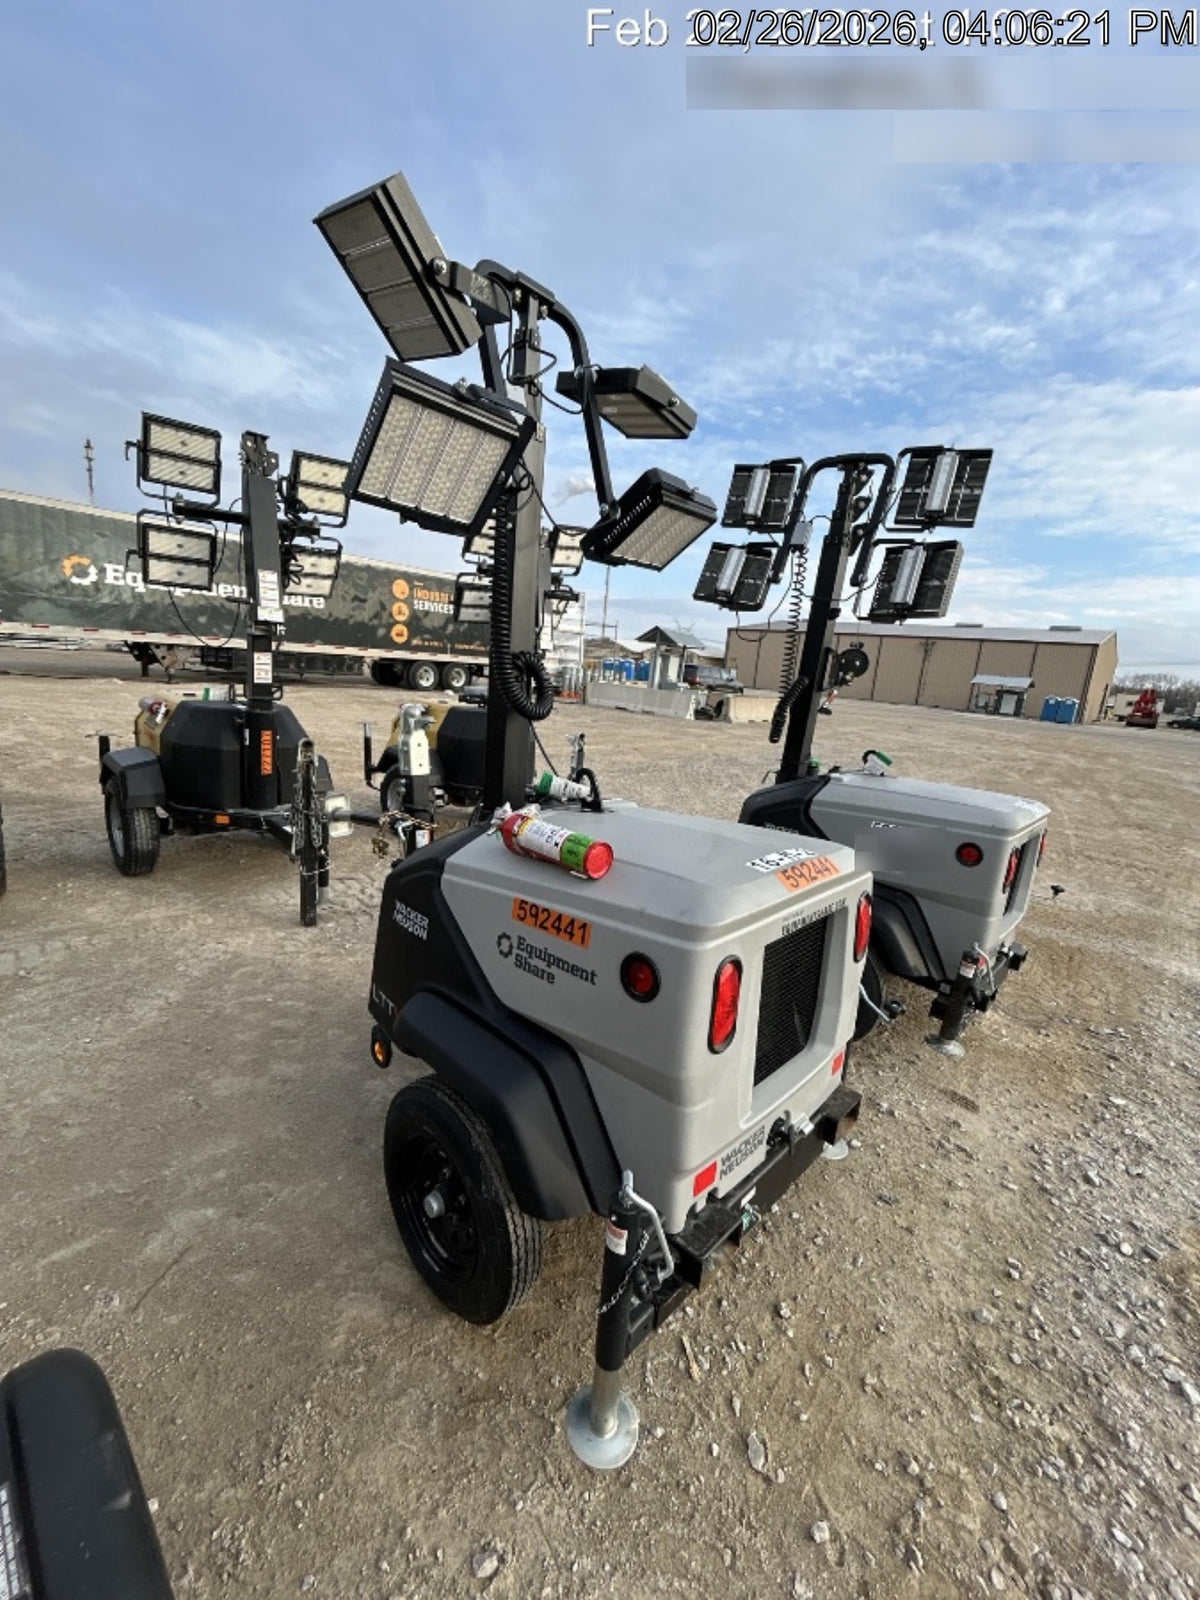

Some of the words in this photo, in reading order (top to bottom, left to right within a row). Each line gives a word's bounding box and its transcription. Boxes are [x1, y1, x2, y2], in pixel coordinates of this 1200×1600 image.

[413, 600, 455, 615] SERVICES
[780, 856, 840, 888] 592441
[516, 898, 588, 945] 592441
[513, 952, 556, 985] Share
[515, 934, 598, 986] Equipment
